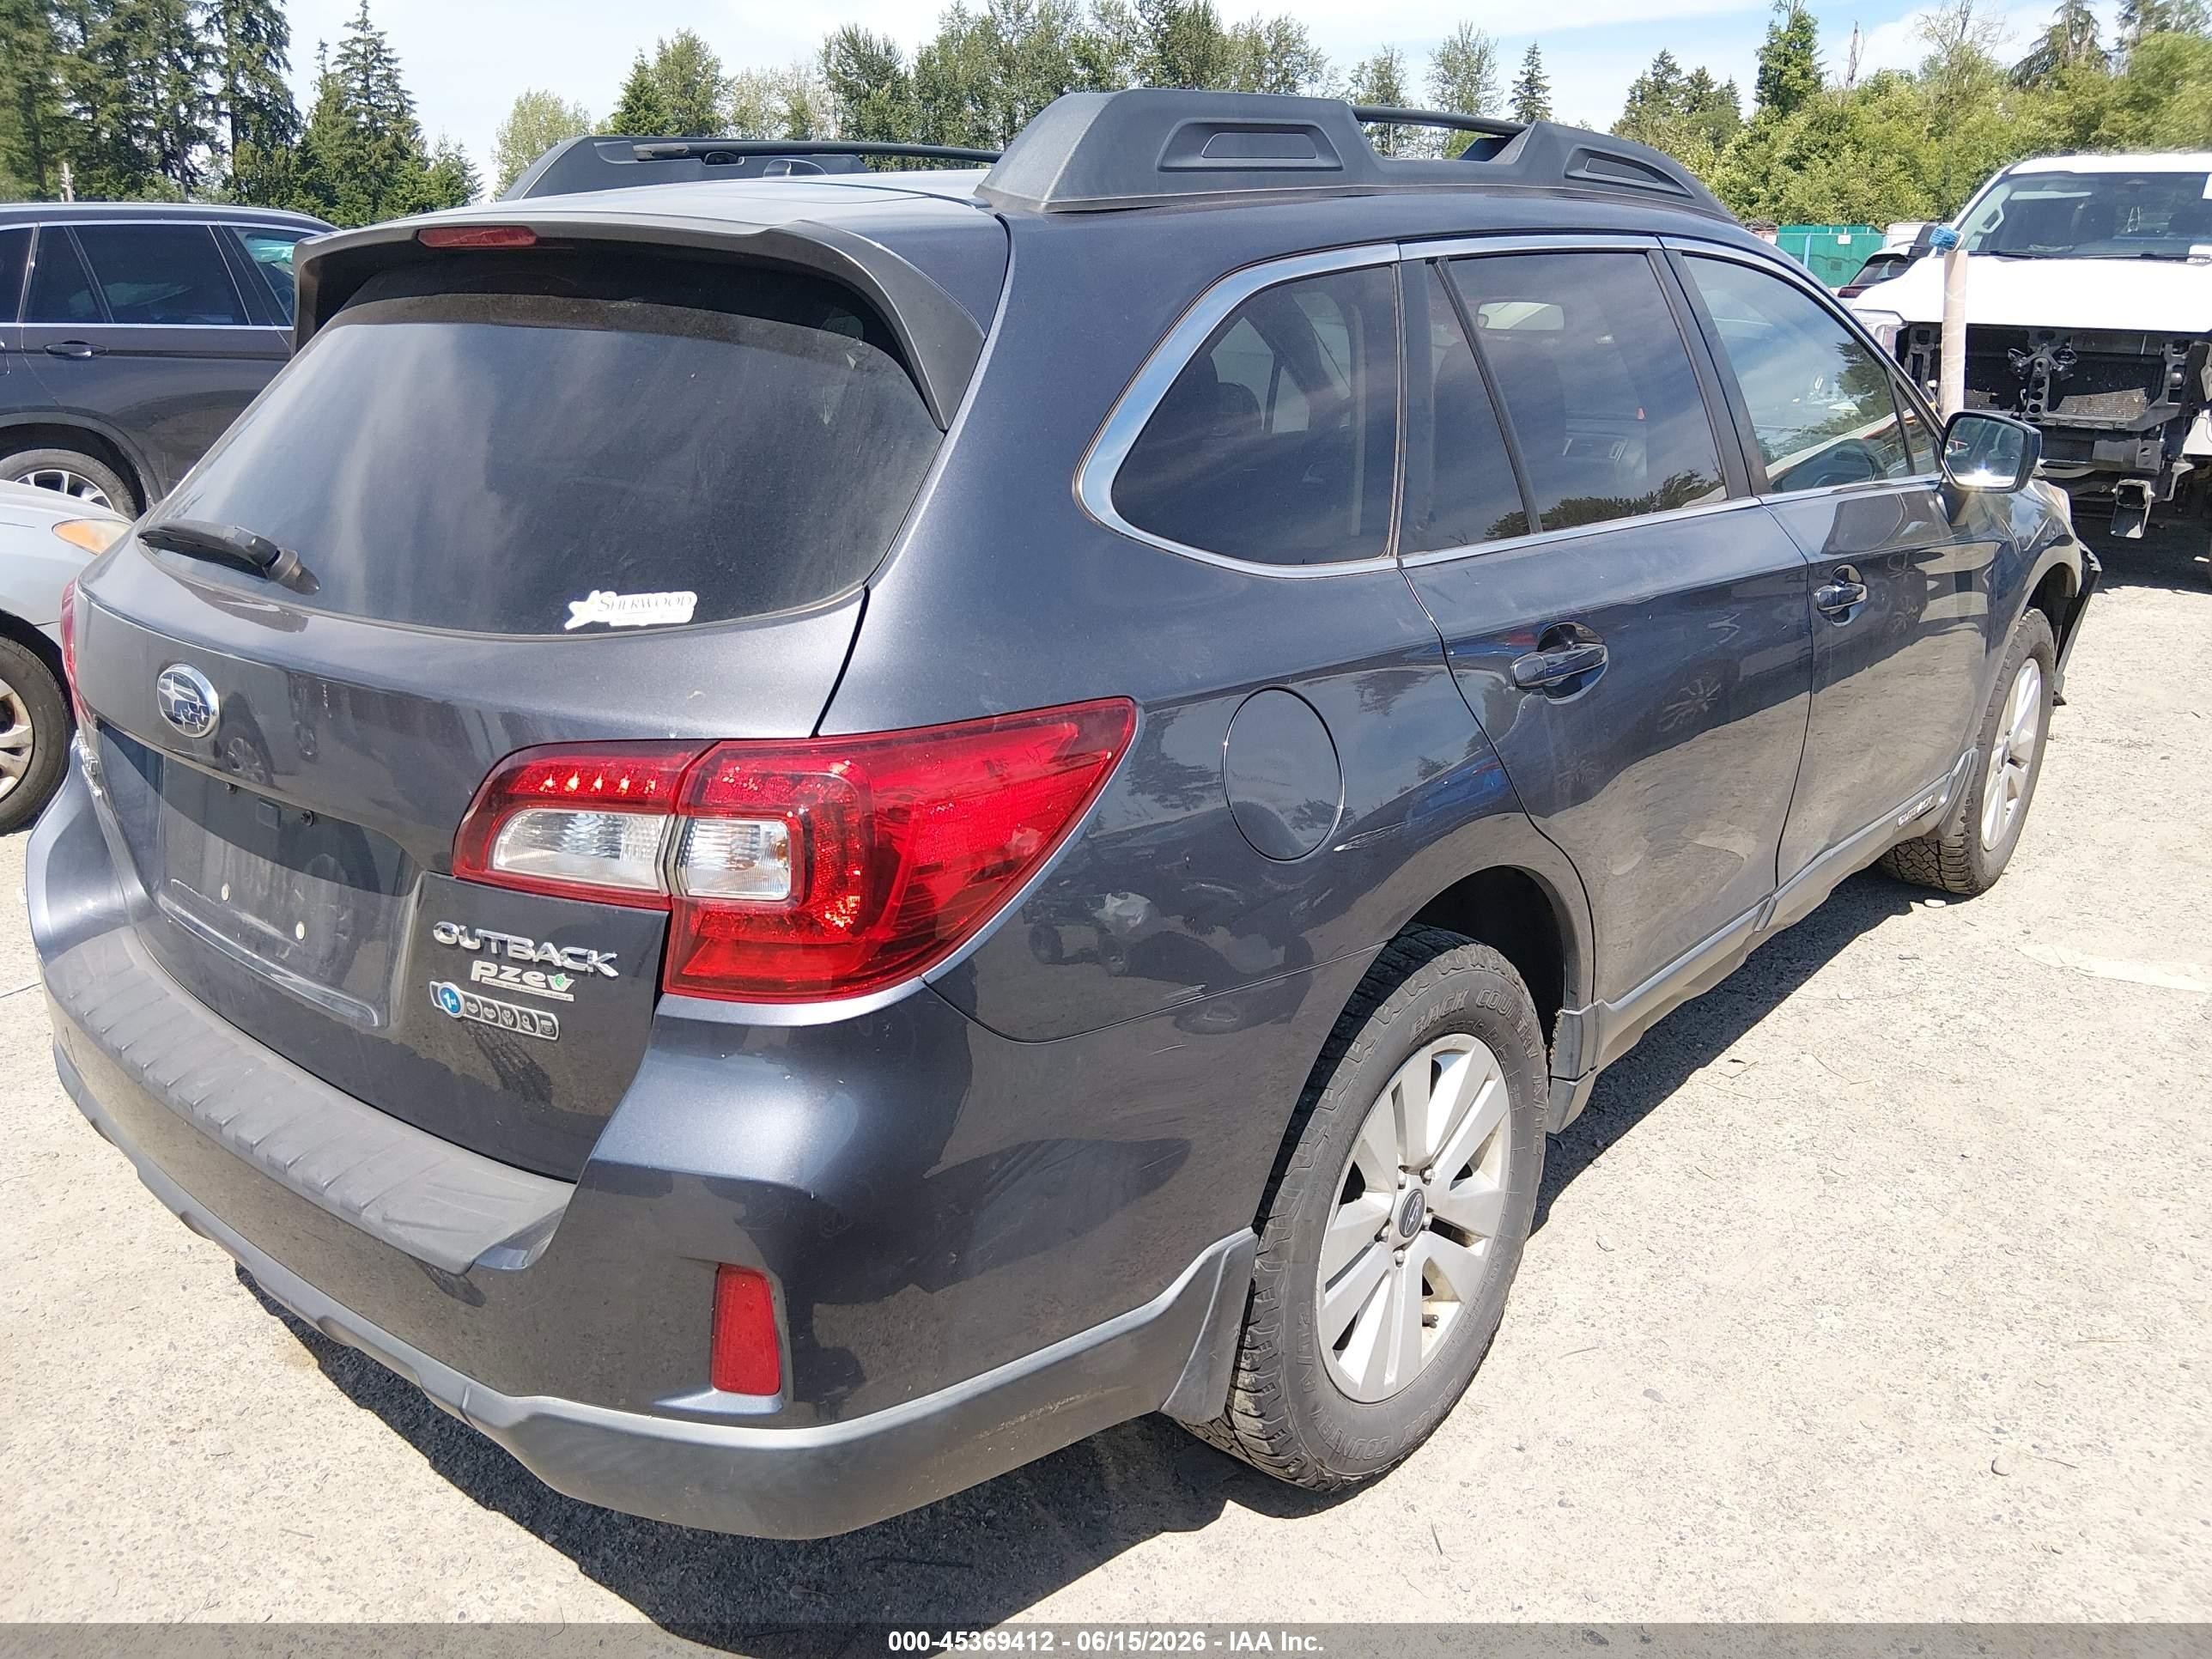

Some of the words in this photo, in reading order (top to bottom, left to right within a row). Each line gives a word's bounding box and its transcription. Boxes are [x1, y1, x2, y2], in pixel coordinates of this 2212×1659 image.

[433, 921, 619, 977] OUTBACK
[1408, 988, 1470, 1045] BACK
[1475, 988, 1540, 1059] COUNTRY
